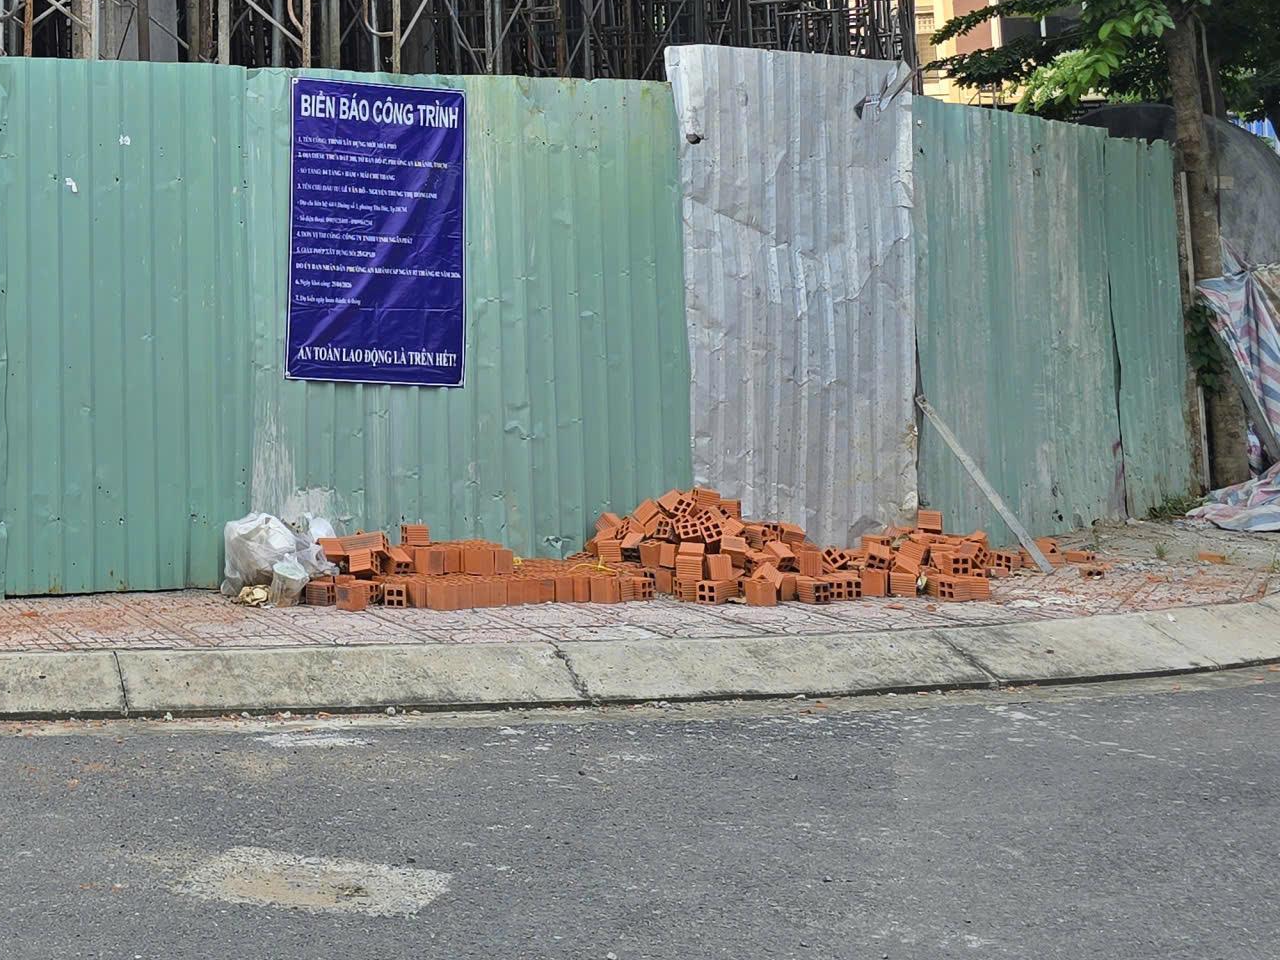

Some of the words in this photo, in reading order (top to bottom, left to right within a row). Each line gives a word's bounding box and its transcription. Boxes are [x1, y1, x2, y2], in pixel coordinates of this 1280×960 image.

[339, 93, 369, 121] BÁO
[373, 97, 414, 125] CÔNG
[417, 100, 459, 128] TRÌNH
[298, 346, 312, 359] AN
[313, 343, 340, 361] TOÀN
[342, 348, 362, 362] LAO
[364, 348, 392, 366] ĐỘNG
[394, 347, 406, 364] LÀ
[408, 348, 433, 365] TRÊN
